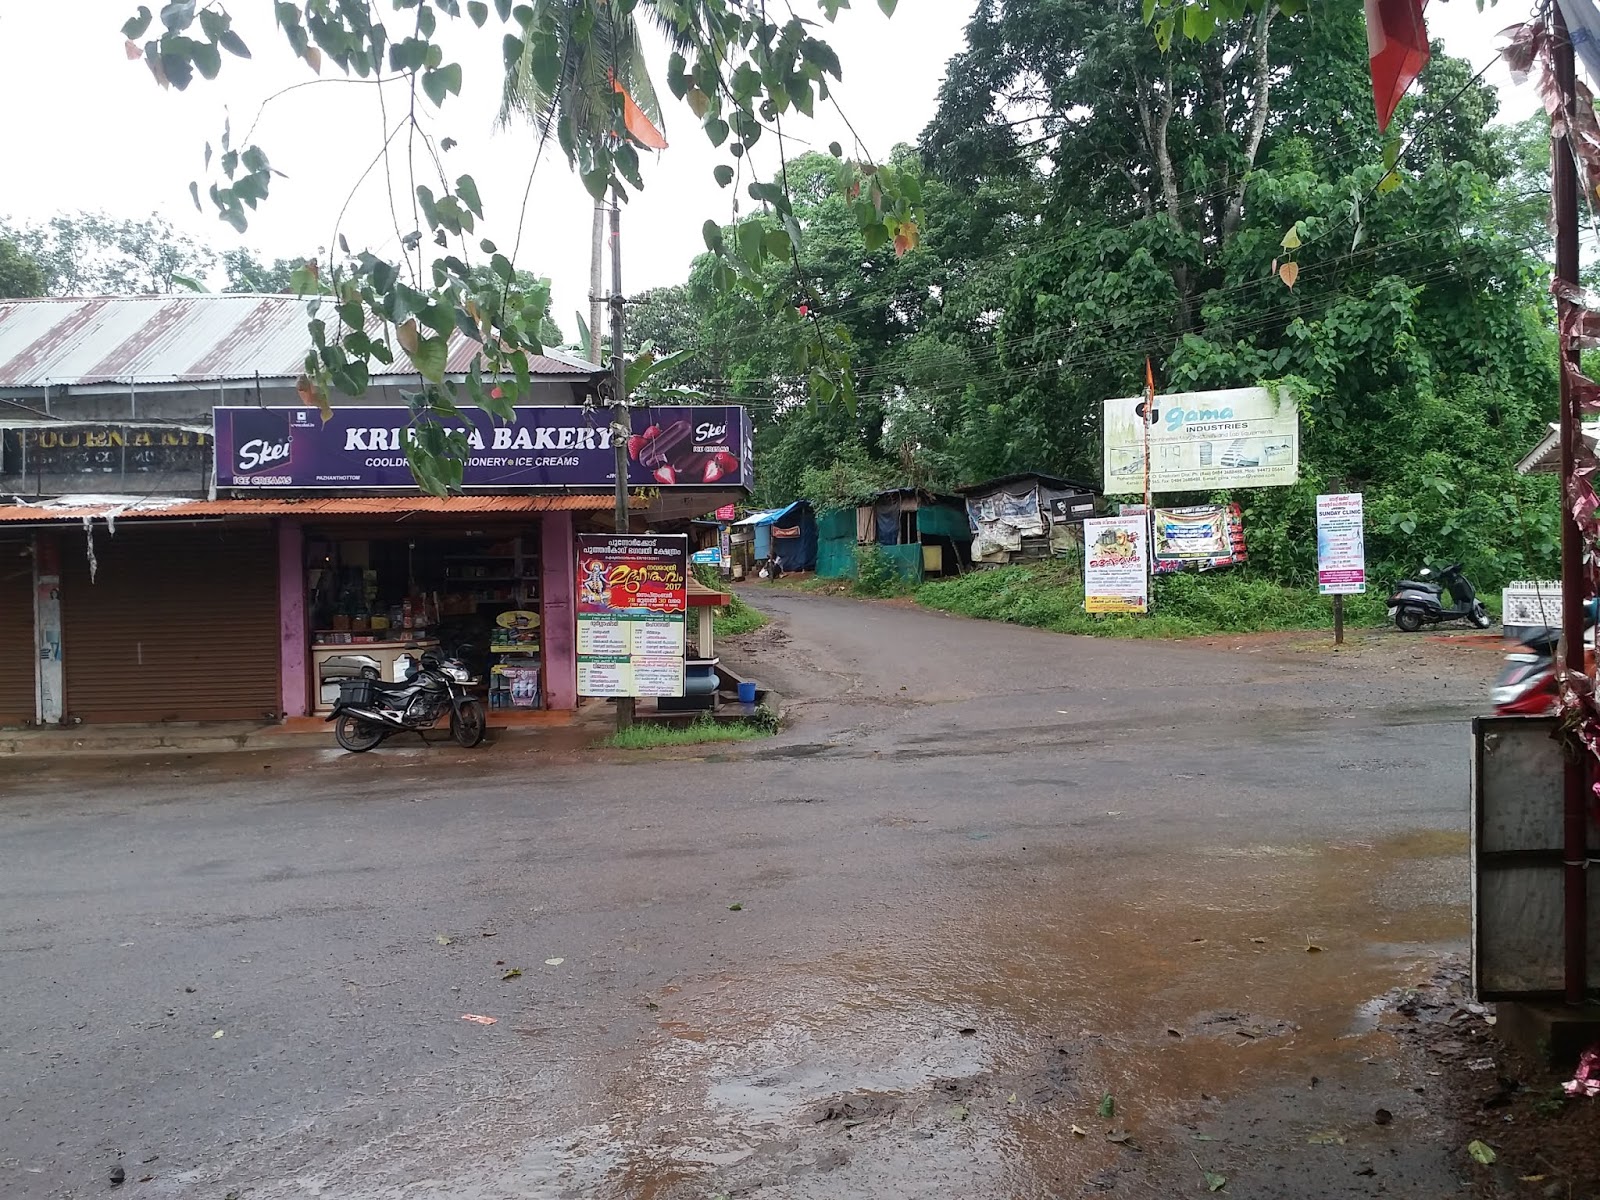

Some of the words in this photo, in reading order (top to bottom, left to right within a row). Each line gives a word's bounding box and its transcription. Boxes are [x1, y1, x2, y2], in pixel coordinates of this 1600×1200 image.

[1165, 405, 1234, 432] gama
[695, 422, 728, 442] Skei
[1186, 422, 1249, 433] INDUSTRIES
[491, 426, 614, 450] BAKERY
[238, 435, 292, 470] Skei
[514, 456, 533, 466] ICE
[534, 456, 580, 466] CREAMS
[232, 475, 250, 485] ICE
[251, 475, 292, 485] CREAMS
[664, 582, 682, 591] 2017
